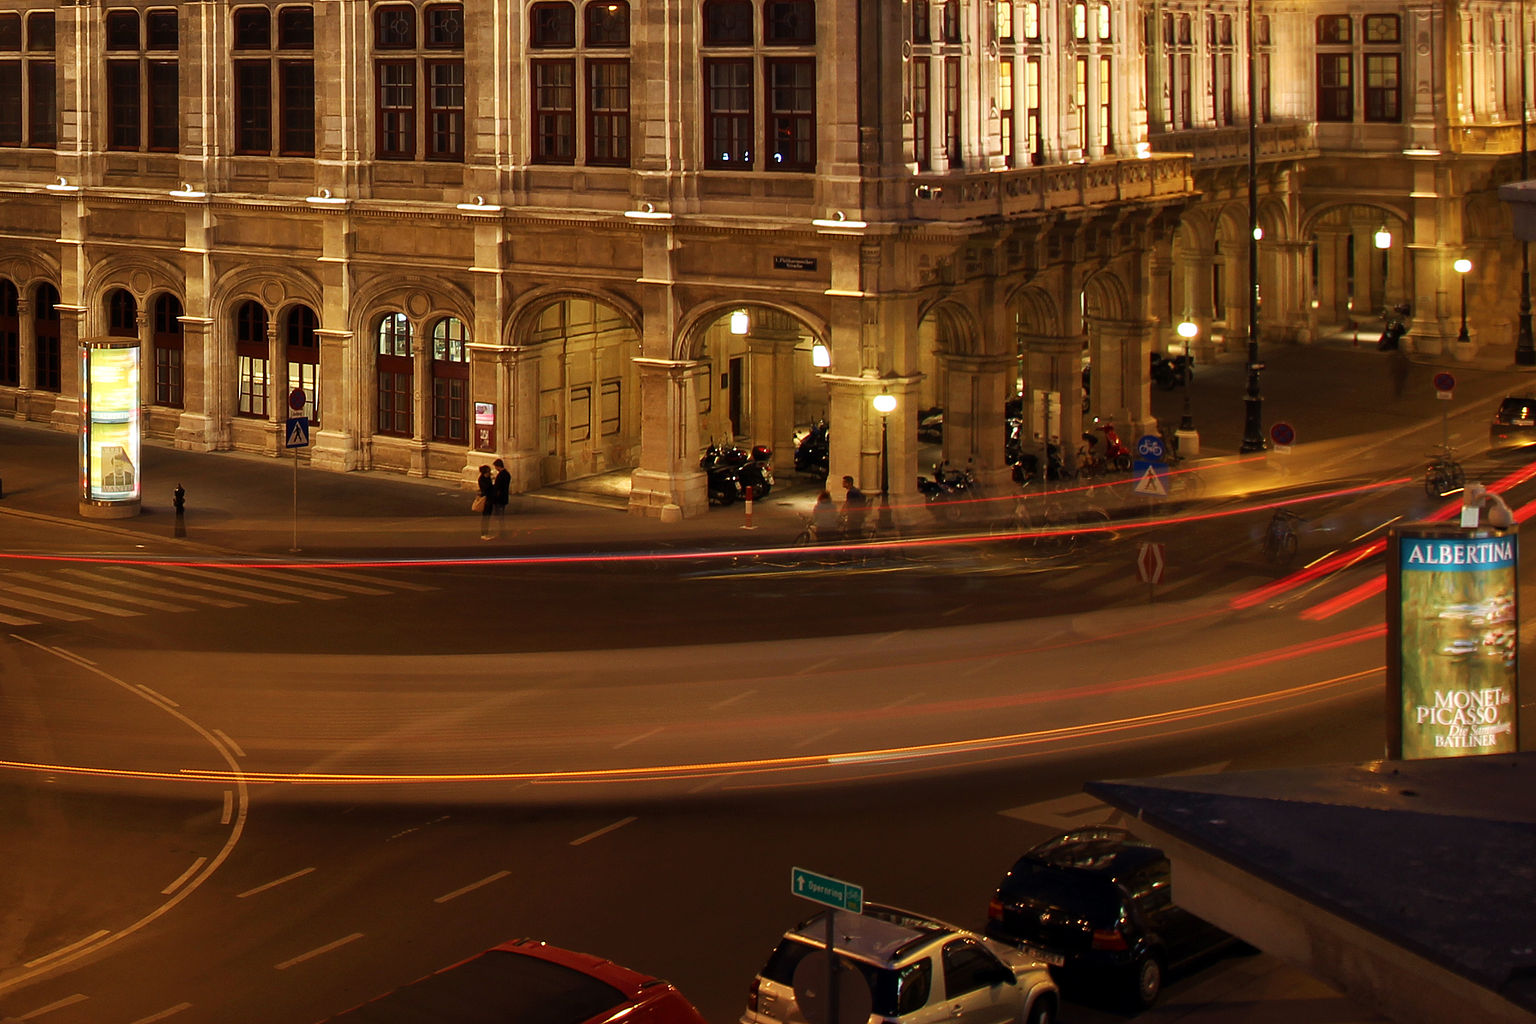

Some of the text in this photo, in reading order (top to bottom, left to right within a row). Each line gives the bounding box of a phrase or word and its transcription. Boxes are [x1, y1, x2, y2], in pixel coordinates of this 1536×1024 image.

[1407, 541, 1514, 564] ALBERTINA
[1435, 687, 1502, 709] MONET
[1416, 705, 1498, 725] PICASSO
[1435, 734, 1496, 748] BATLINER
[1449, 725, 1469, 737] Die
[808, 880, 843, 901] Opernring
